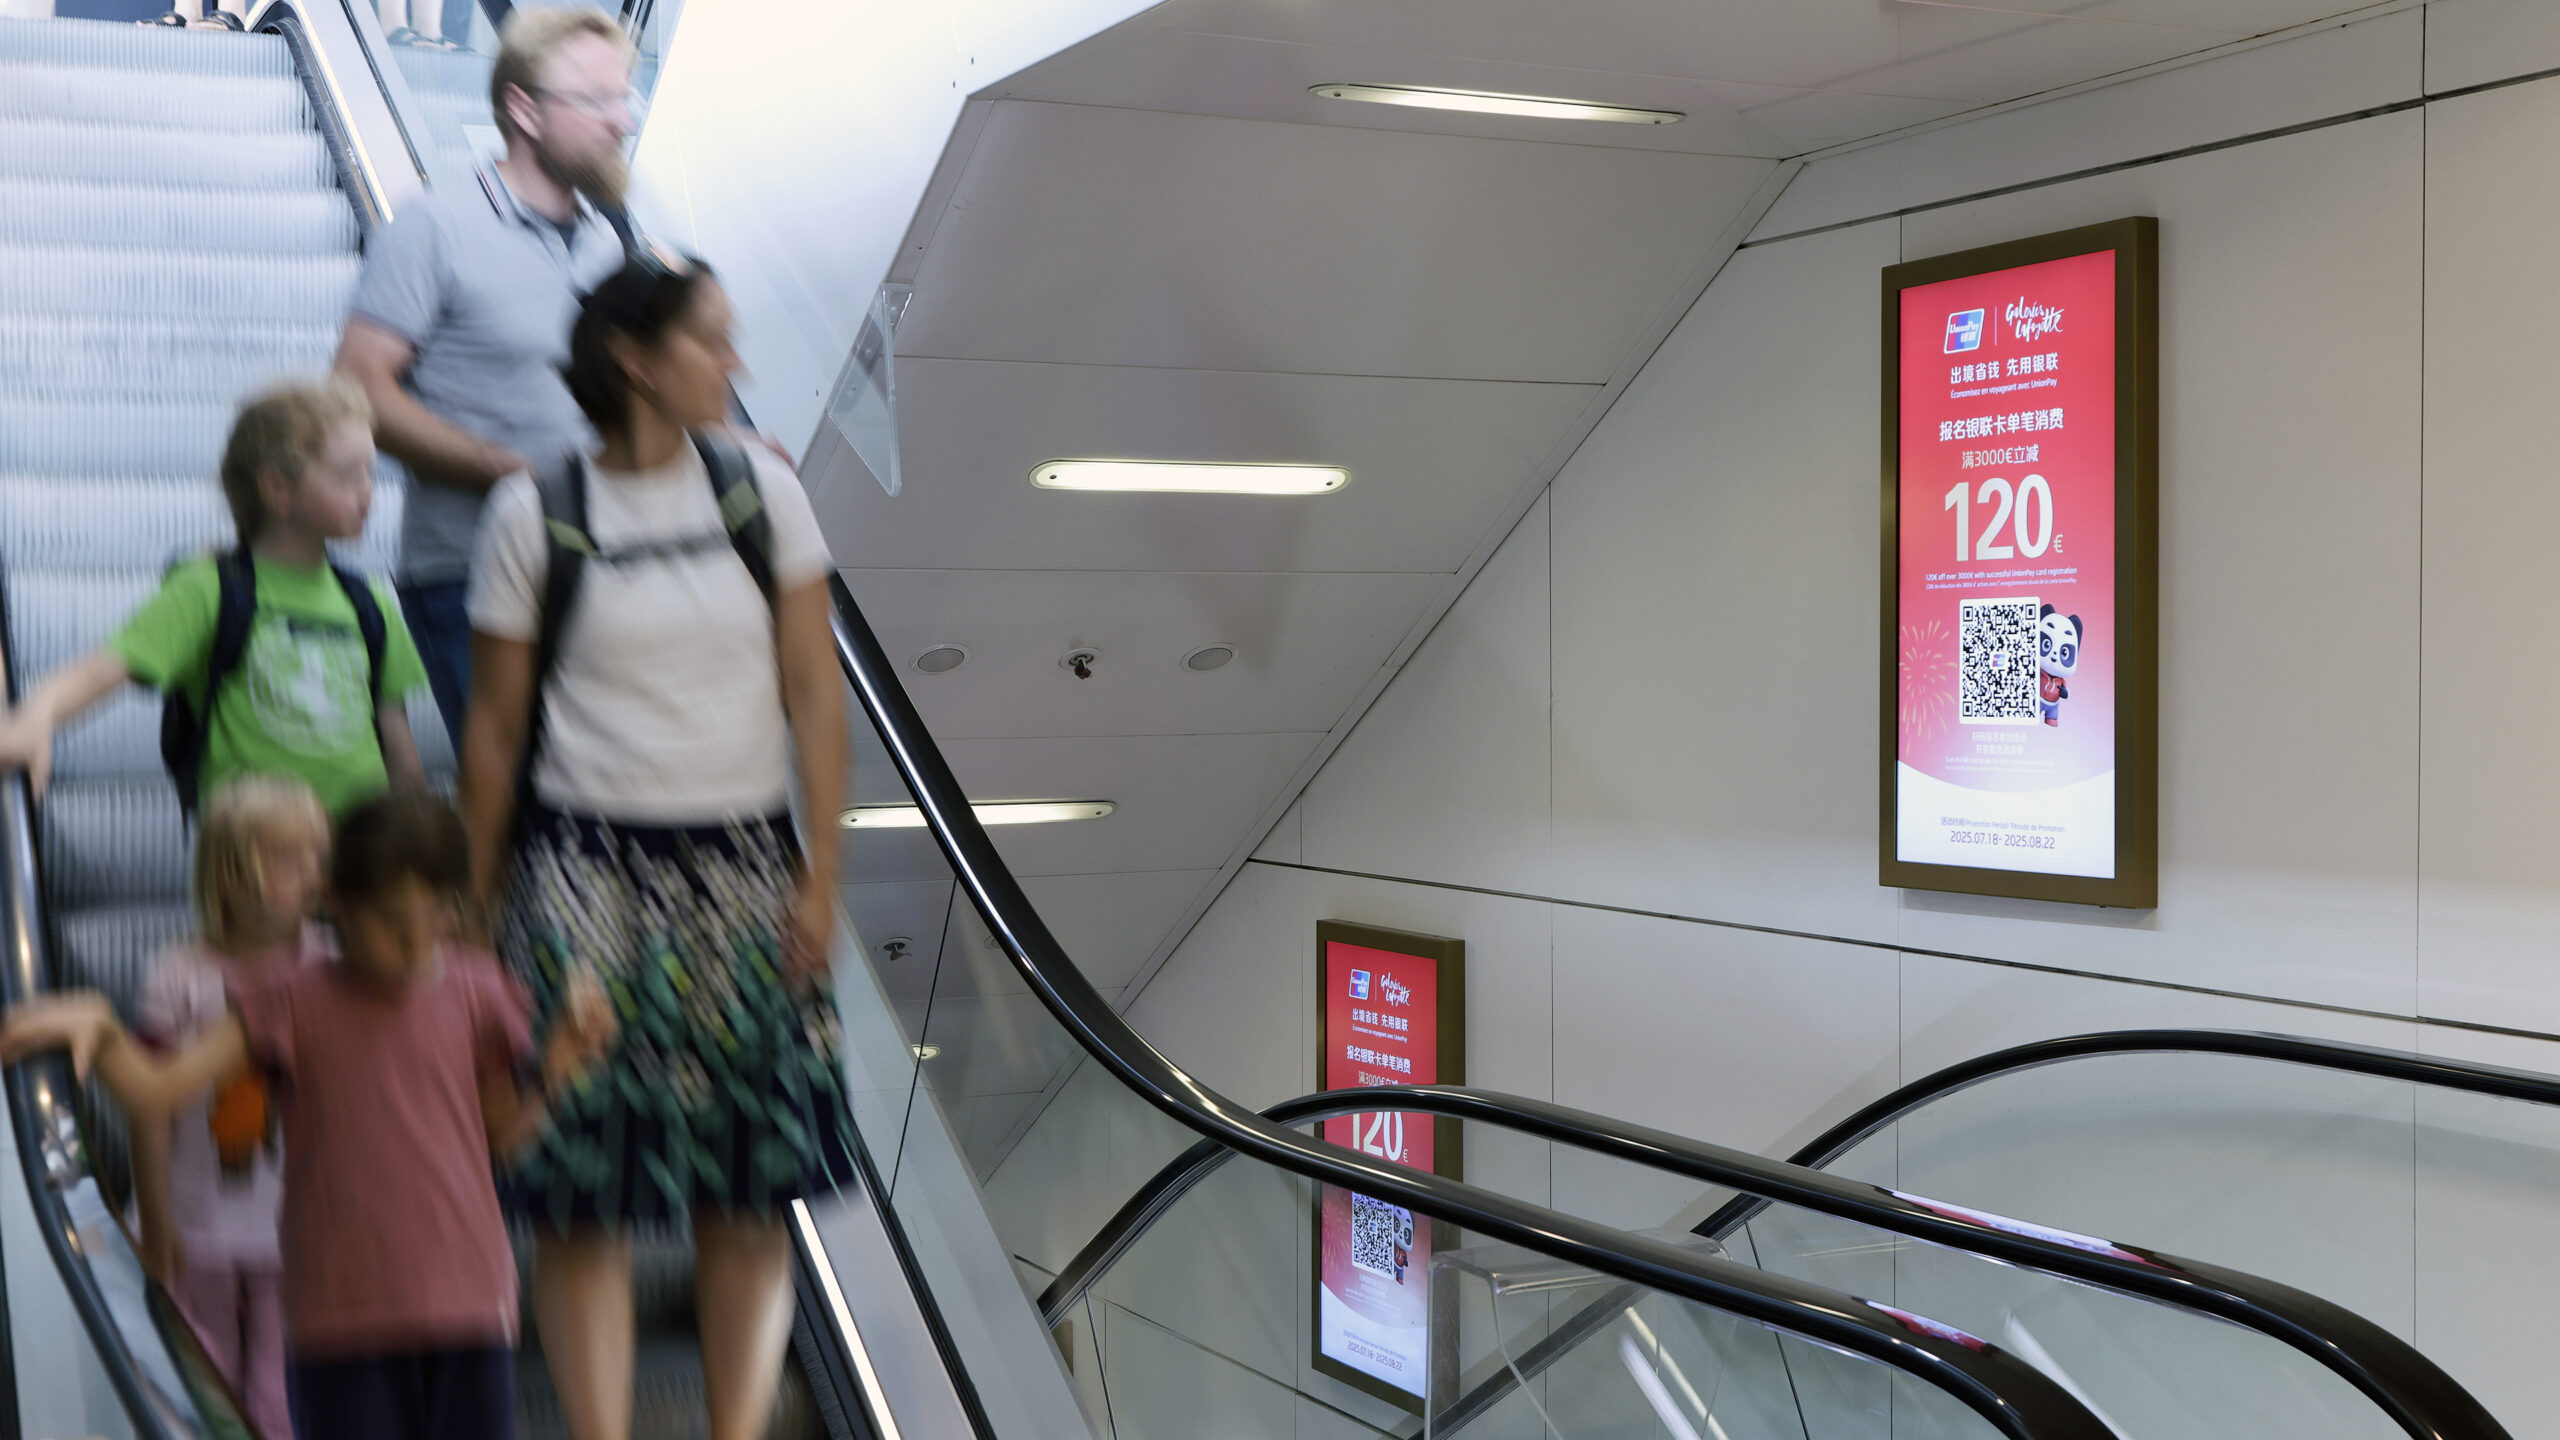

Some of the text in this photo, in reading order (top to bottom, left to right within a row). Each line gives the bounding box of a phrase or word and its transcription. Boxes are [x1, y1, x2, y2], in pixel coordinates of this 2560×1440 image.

[1949, 321, 1980, 334] UnionPay
[1950, 352, 2059, 384] 出境省钱 先用银联
[1989, 383, 2017, 395] voyageant
[2017, 382, 2031, 390] avec
[2031, 378, 2058, 388] UnionPay
[1939, 407, 2064, 442] 报名银联卡单笔消费
[1961, 443, 2039, 469] 满3000€立减
[2011, 567, 2035, 577] UnionPay
[2035, 568, 2047, 576] card
[2047, 566, 2078, 576] registration
[2004, 834, 2056, 850] 2025.08.22
[1346, 1044, 1411, 1075] 报名银联卡单笔消费
